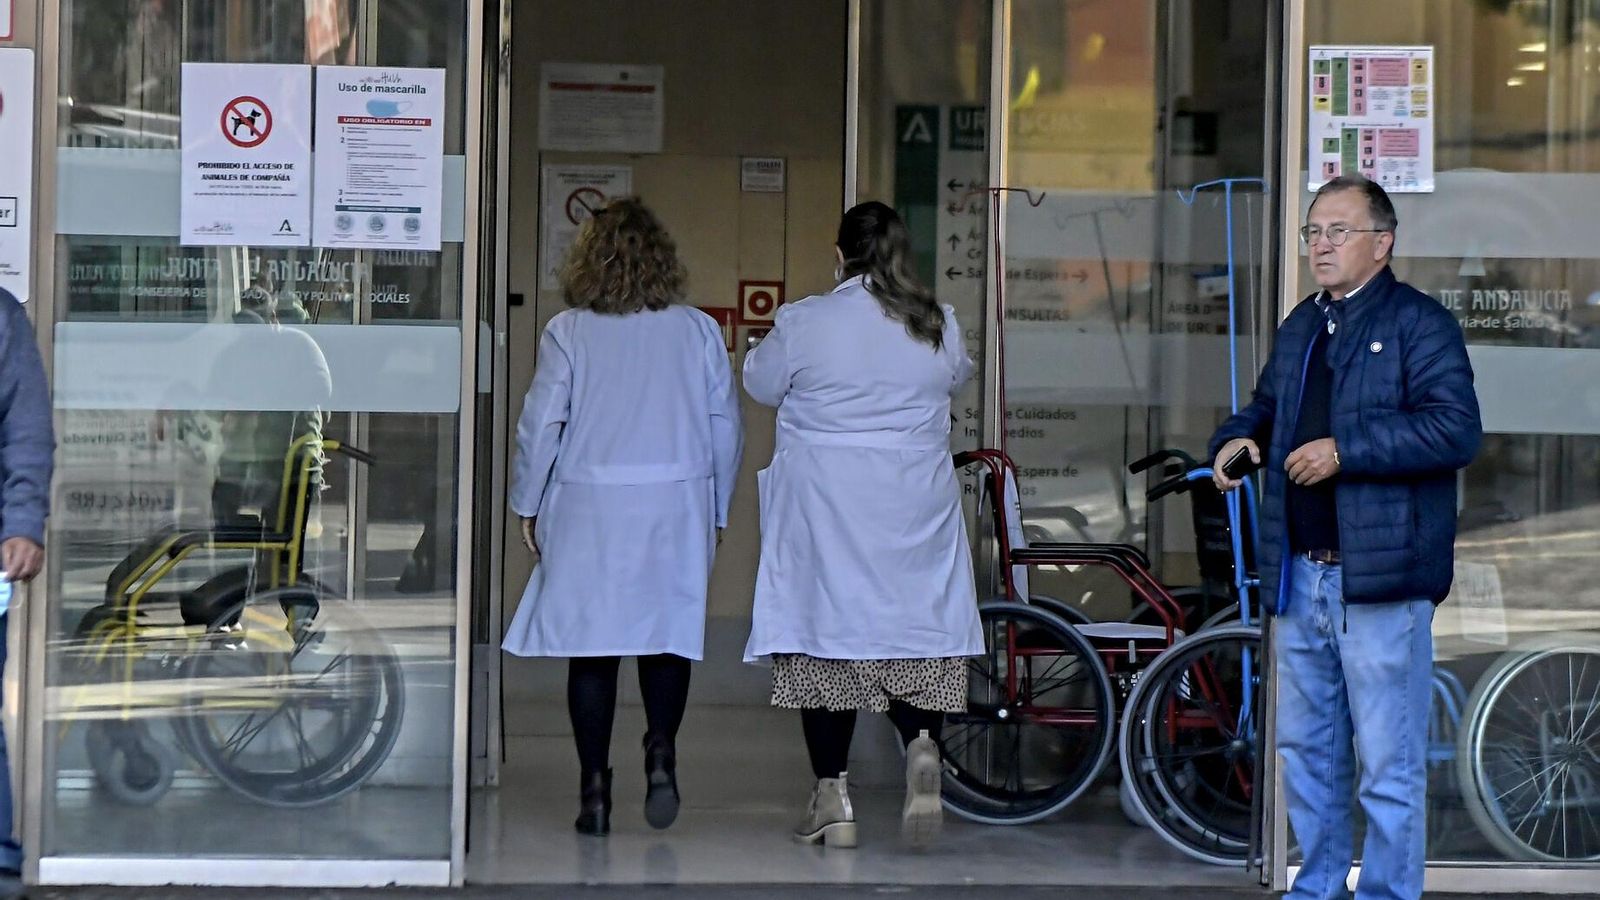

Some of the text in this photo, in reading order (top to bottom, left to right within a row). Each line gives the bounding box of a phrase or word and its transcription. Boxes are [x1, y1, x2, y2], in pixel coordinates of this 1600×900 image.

[338, 83, 427, 95] Uso de mascarilla
[369, 292, 410, 304] OCIALES
[1440, 289, 1463, 310] DE
[1481, 316, 1500, 329] de
[1015, 408, 1077, 420] Cuidados
[1015, 465, 1060, 479] Espera
[1062, 465, 1079, 477] de
